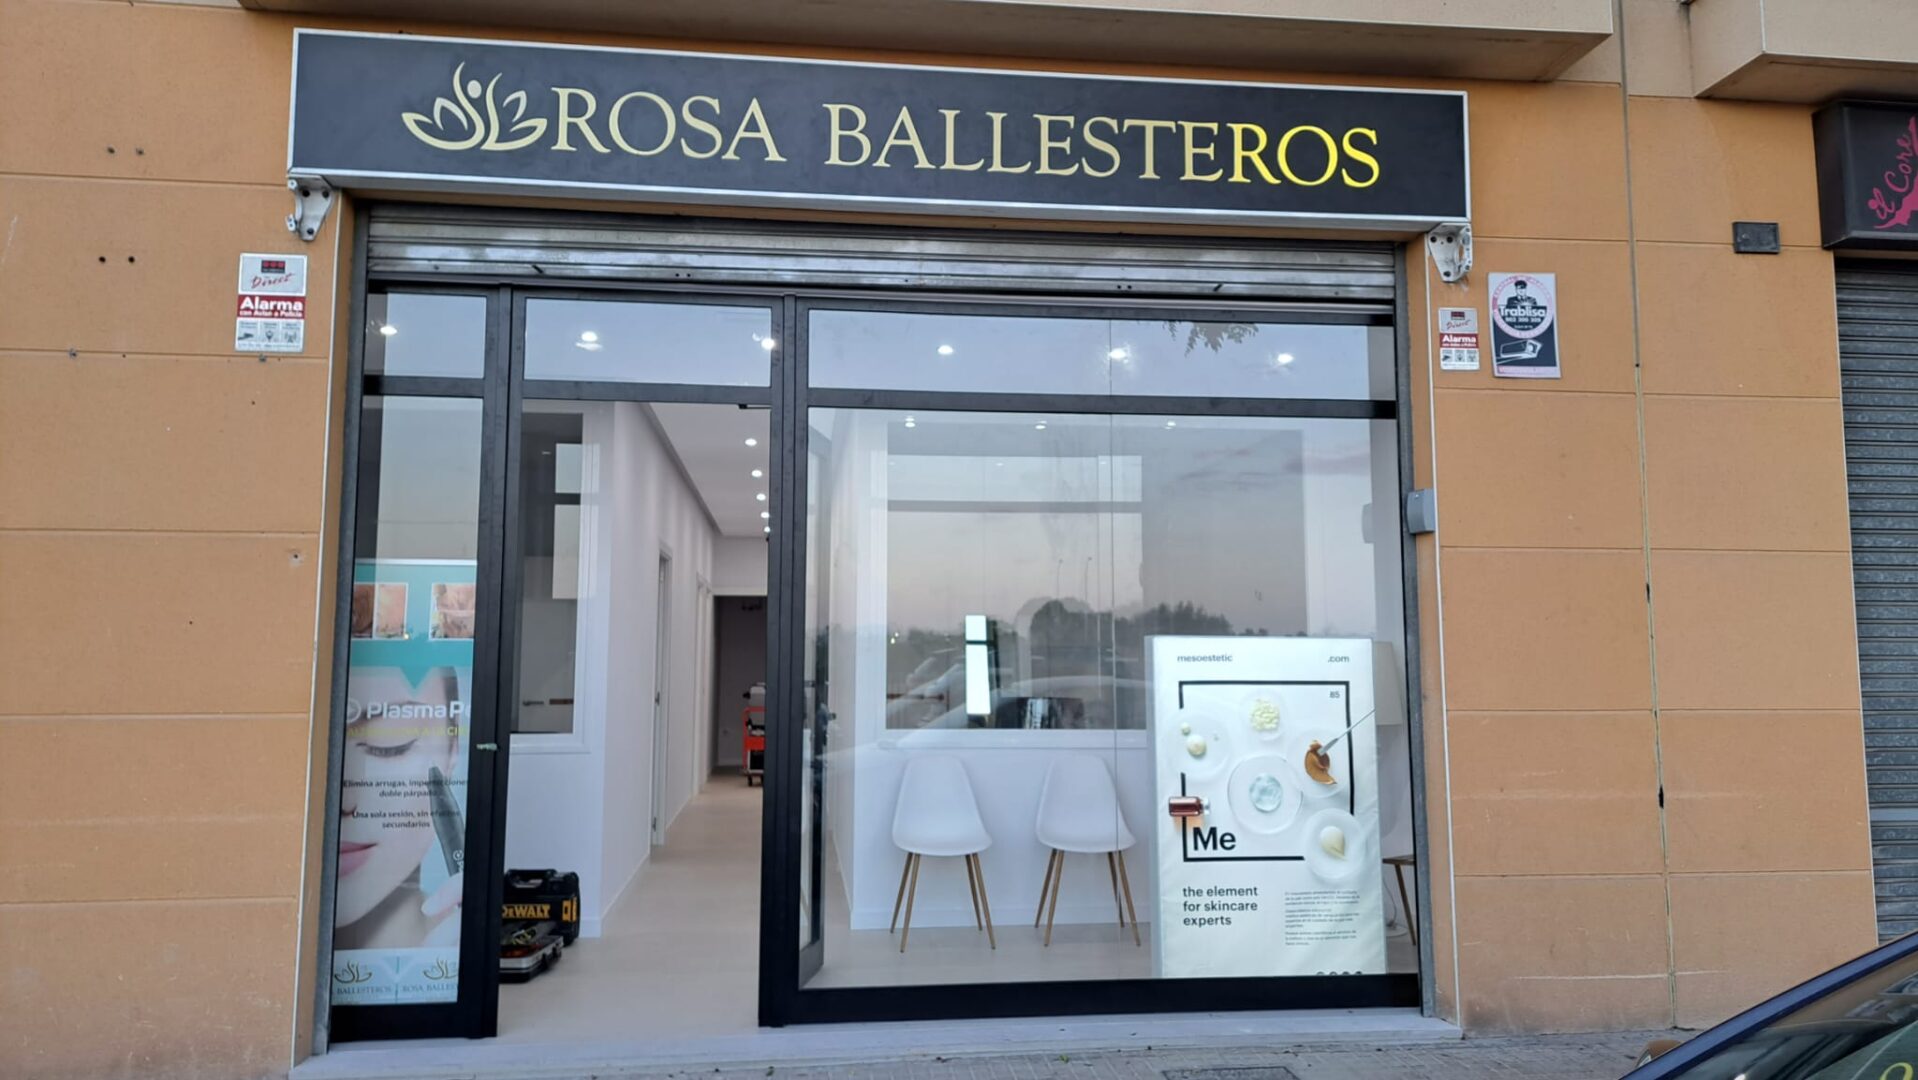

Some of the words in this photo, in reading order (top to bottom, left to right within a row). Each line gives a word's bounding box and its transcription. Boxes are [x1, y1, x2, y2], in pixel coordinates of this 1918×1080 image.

[551, 87, 787, 162] ROSA
[822, 104, 1380, 188] BALLESTEROS
[240, 296, 303, 311] Alarma
[1499, 305, 1546, 317] Trablisa
[1442, 334, 1477, 343] Alarma
[1177, 653, 1233, 663] mesoestetic
[1327, 654, 1350, 663] .com
[1192, 826, 1237, 851] Me
[1182, 886, 1203, 897] the
[1206, 886, 1258, 897] element
[1183, 901, 1201, 912] for
[1204, 900, 1258, 912] skincare
[1183, 915, 1232, 928] experts
